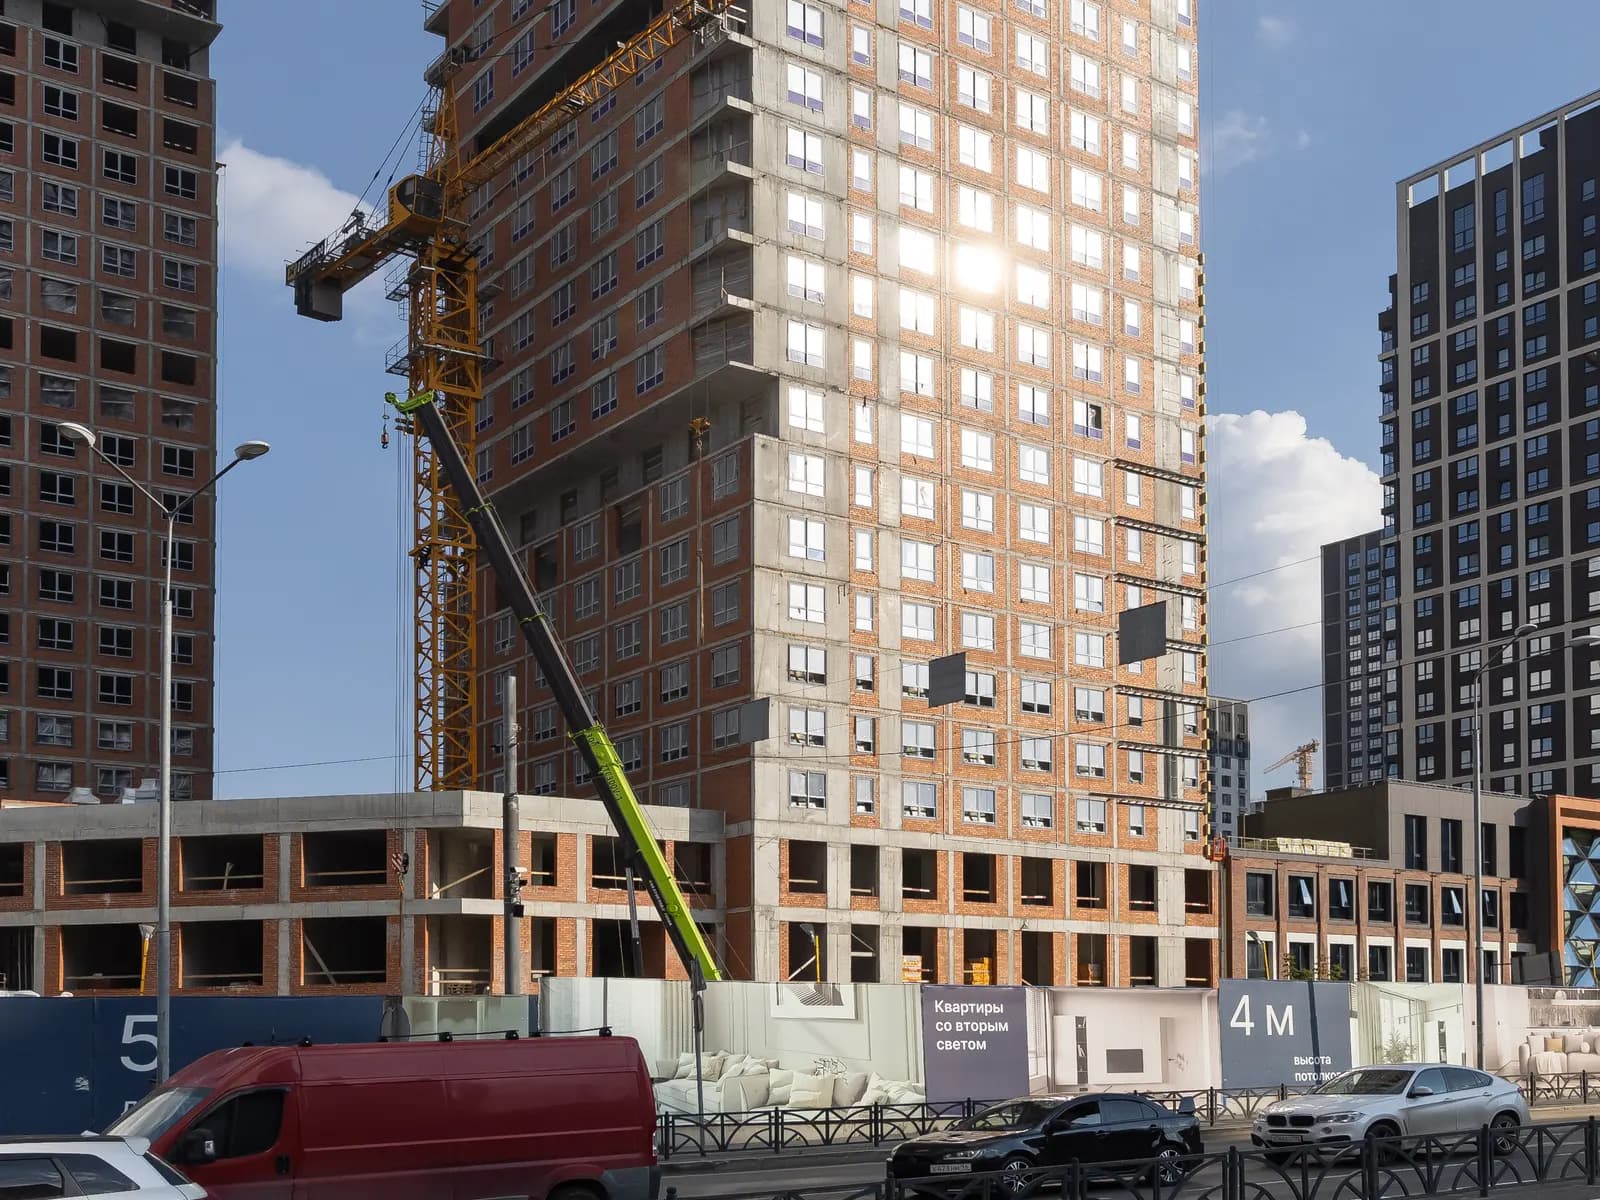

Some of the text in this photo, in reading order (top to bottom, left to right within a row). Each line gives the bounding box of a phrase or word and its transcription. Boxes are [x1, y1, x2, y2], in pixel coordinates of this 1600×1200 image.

[934, 1000, 1004, 1017] Квартиры
[1230, 994, 1255, 1036] 4
[935, 1021, 1009, 1035] со вторым
[120, 1014, 158, 1072] 5
[936, 1040, 987, 1050] светом
[1294, 1056, 1332, 1066] высота
